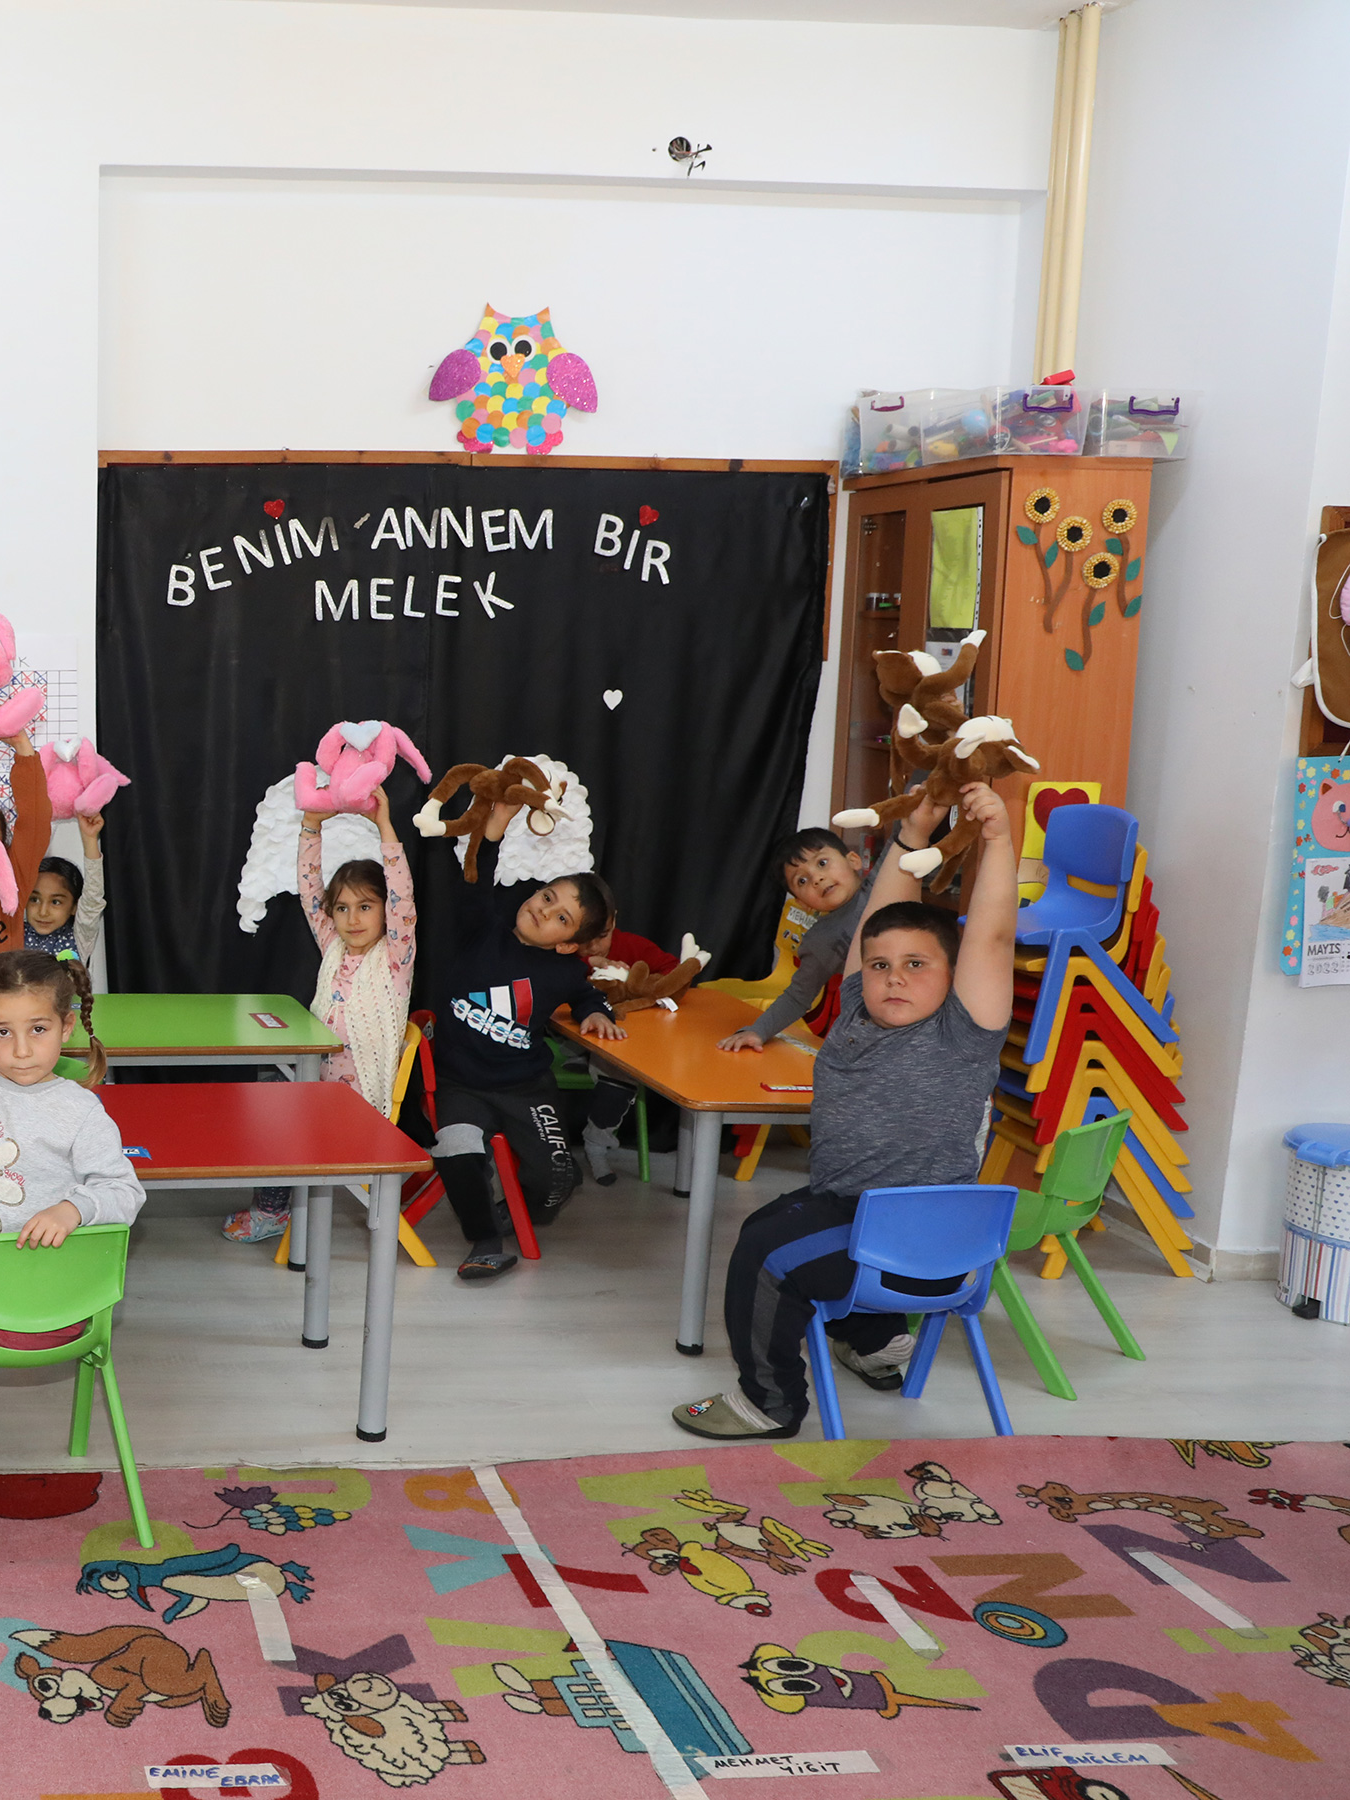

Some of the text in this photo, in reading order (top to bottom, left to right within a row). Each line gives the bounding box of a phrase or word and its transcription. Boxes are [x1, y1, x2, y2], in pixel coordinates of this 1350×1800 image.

[371, 505, 553, 552] ANNEM
[314, 571, 515, 621] MELEK
[1307, 943, 1341, 956] MAYIS
[714, 1755, 794, 1769] MEHMET
[150, 1766, 220, 1779] EMİNE
